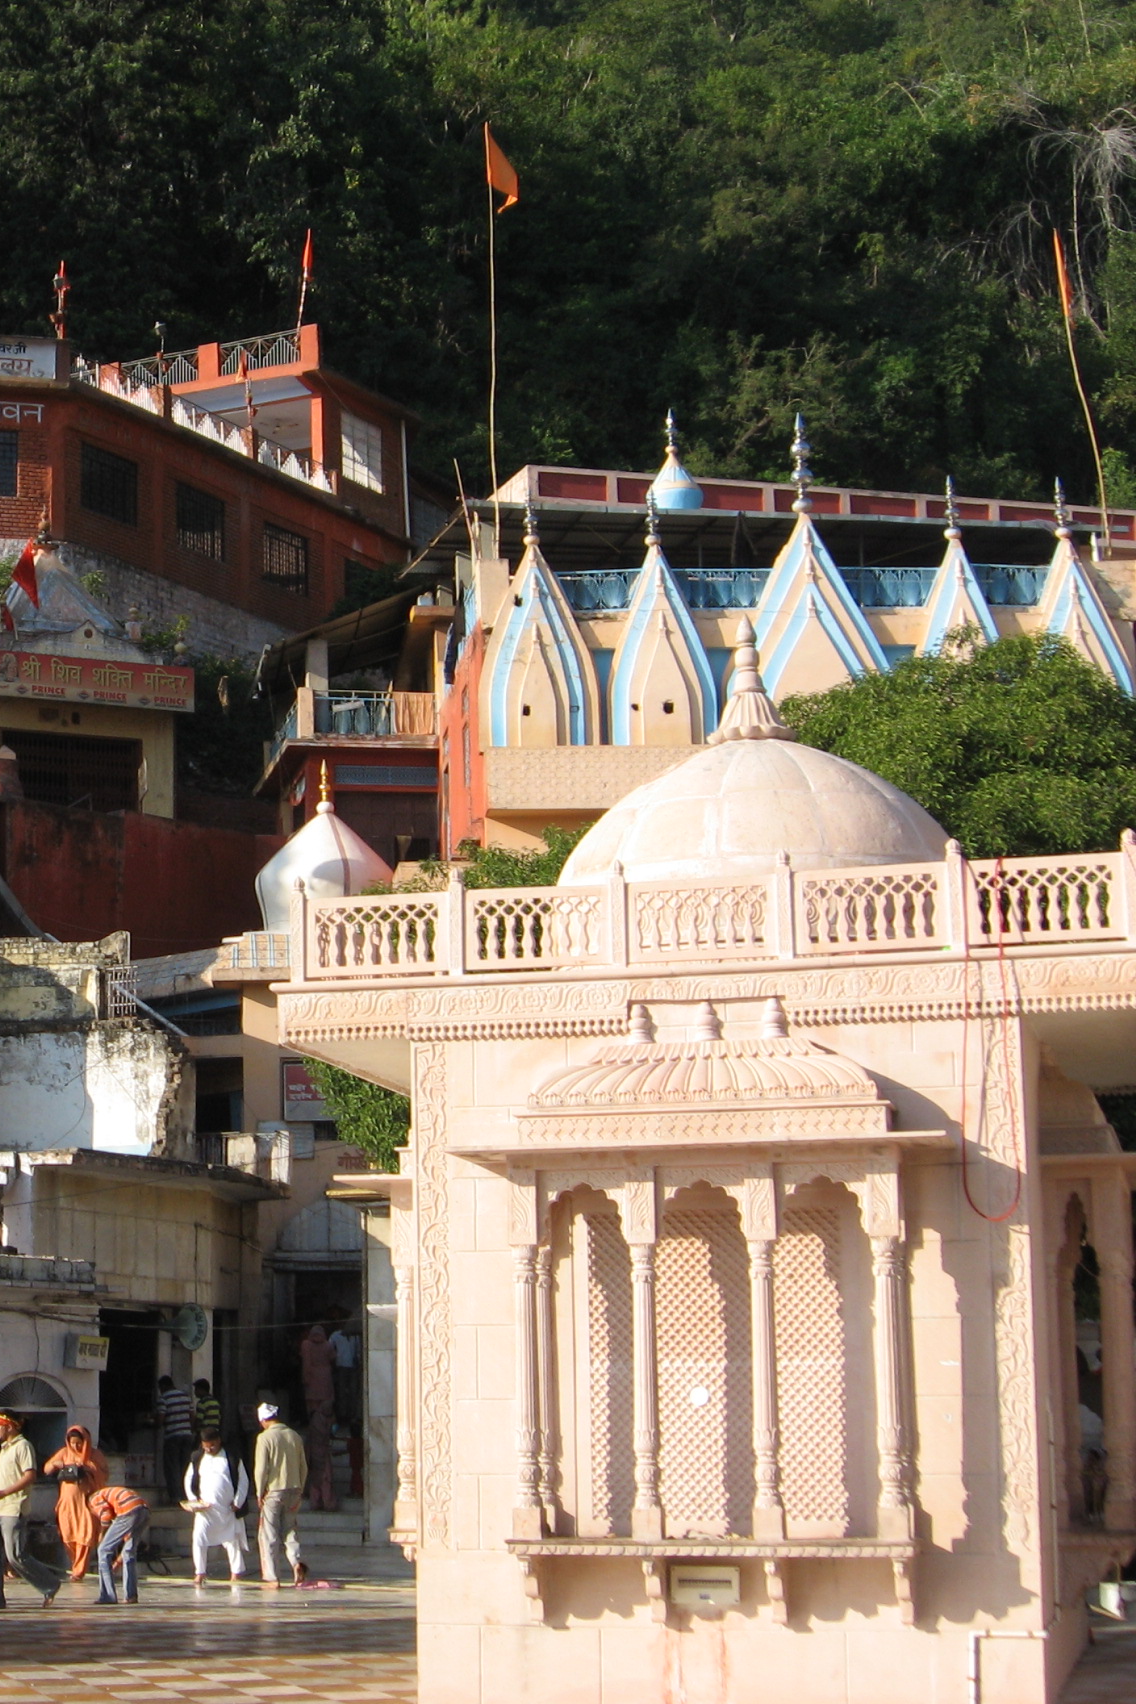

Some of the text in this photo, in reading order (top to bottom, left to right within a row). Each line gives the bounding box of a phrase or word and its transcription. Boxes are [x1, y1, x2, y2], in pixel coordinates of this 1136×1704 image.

[21, 655, 189, 694] श्री शिव शक्ति मन्दिर
[32, 685, 66, 695] PRINCE
[93, 691, 127, 701] PRINCE
[153, 696, 187, 706] PRINCE
